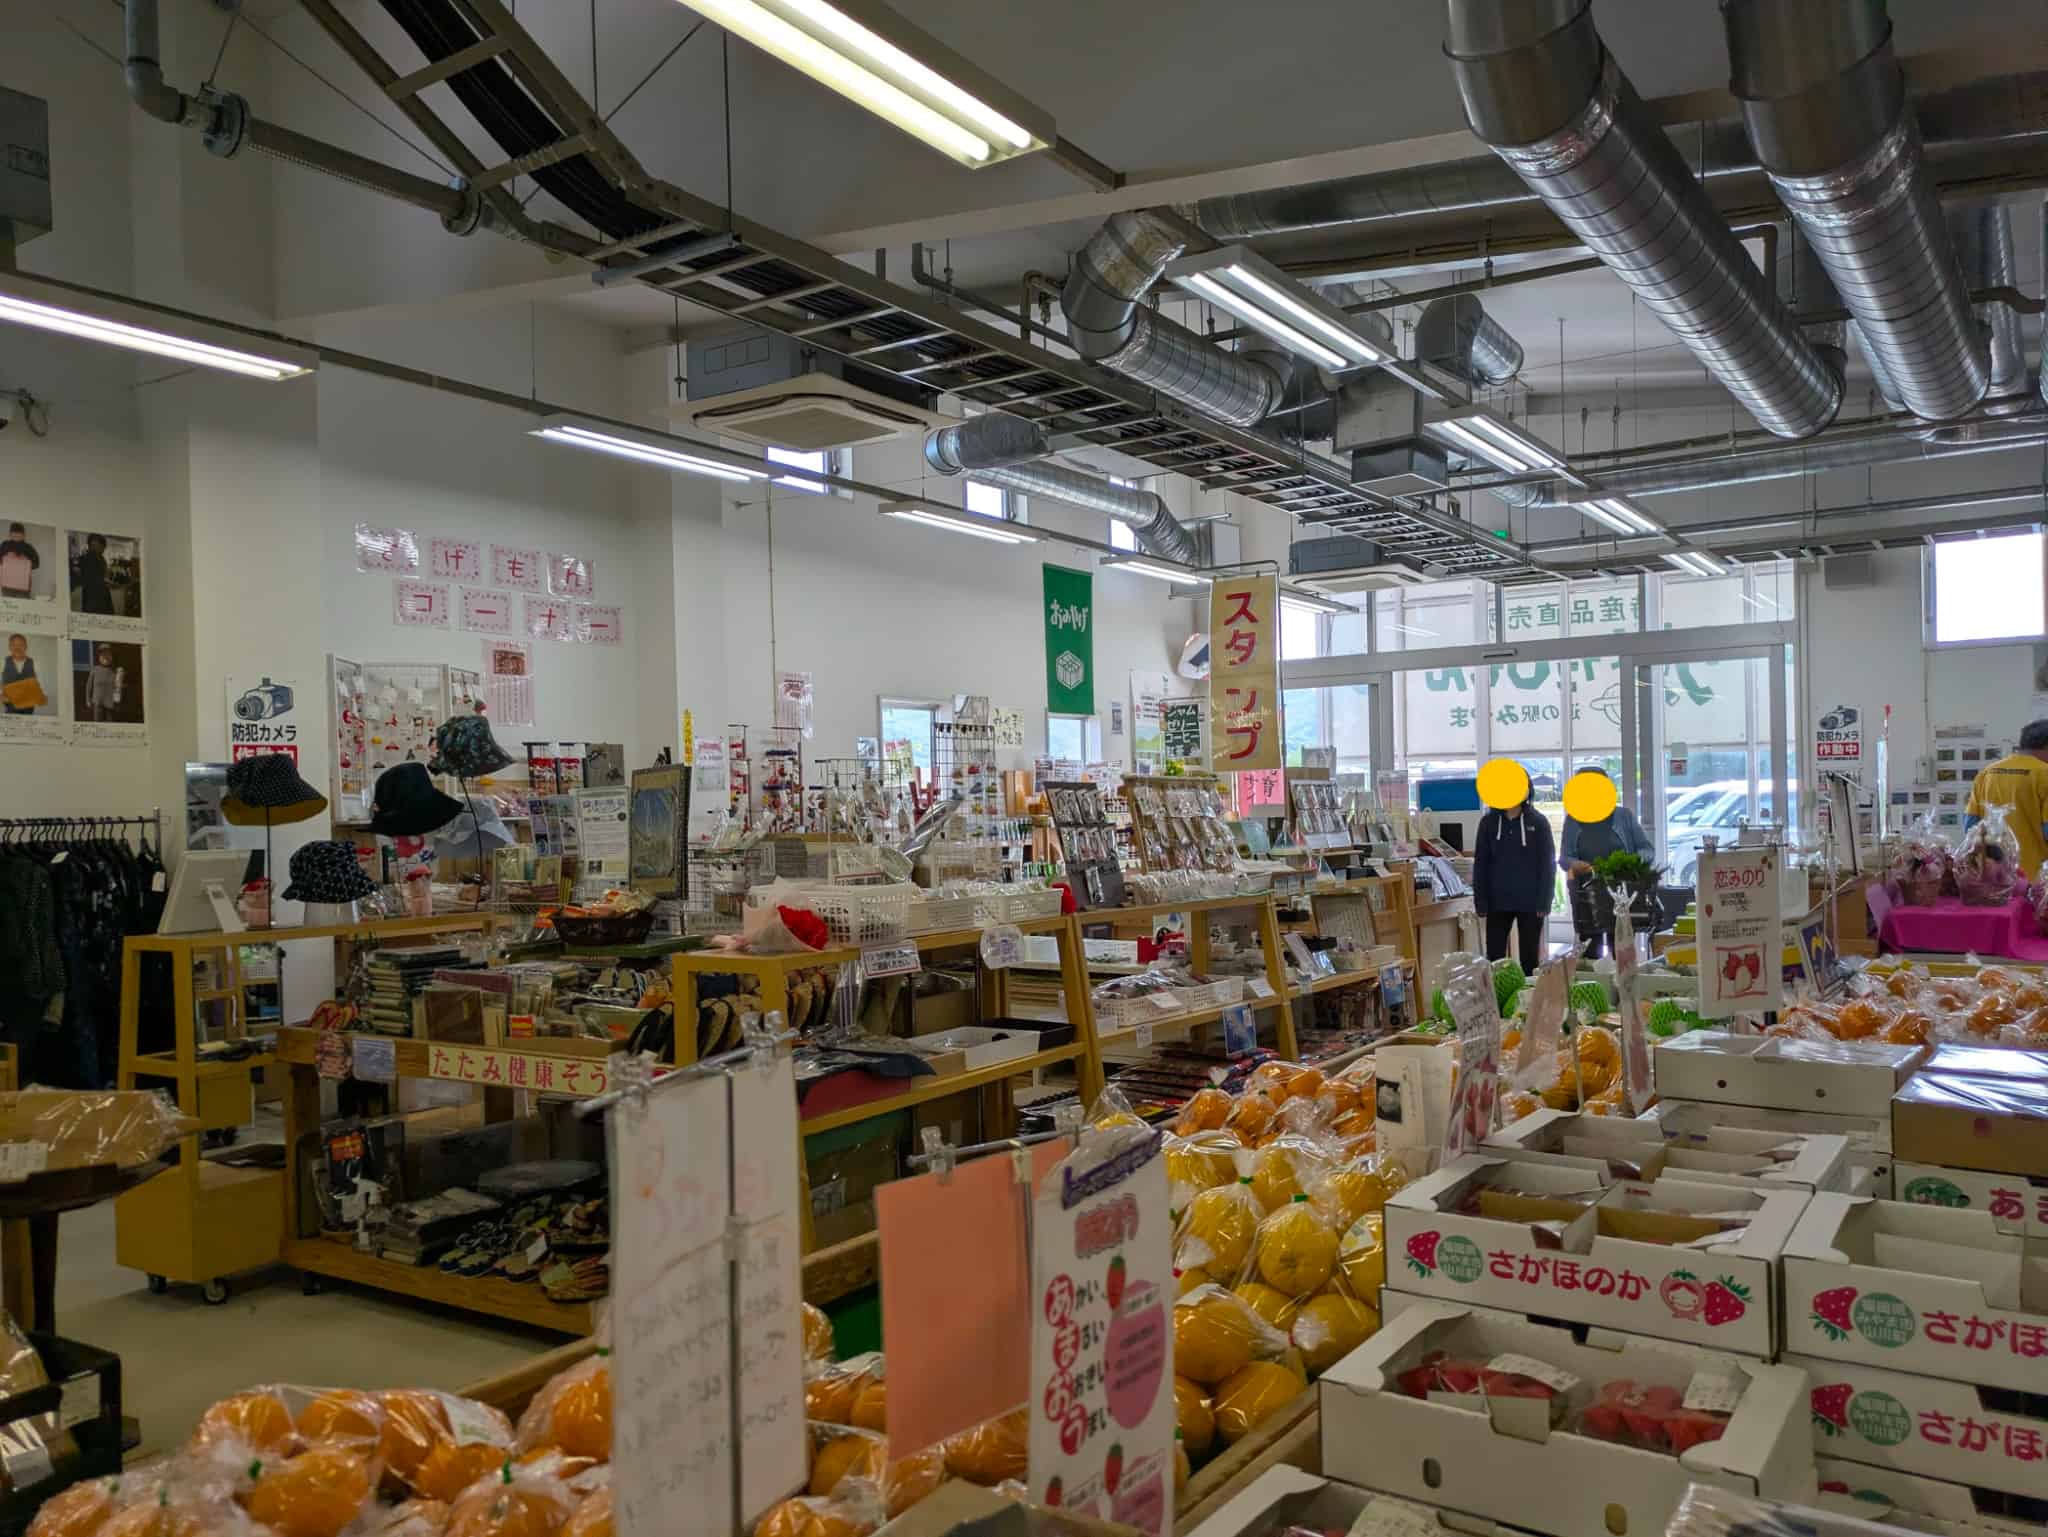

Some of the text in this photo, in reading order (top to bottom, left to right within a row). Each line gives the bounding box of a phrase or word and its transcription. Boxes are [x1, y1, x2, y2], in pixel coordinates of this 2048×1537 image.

[413, 594, 608, 628] コーナー
[1051, 599, 1089, 633] おみやげ
[1223, 591, 1263, 760] スタンプ
[232, 722, 297, 742] 防犯カメラ
[1816, 730, 1860, 742] 防犯カメラ
[1818, 743, 1859, 756] 作動中
[1713, 867, 1766, 890] 恋みのり
[1487, 1250, 1652, 1302] さがほのか
[1920, 1310, 2048, 1358] さがほ
[1917, 1409, 2048, 1462] さがほ
